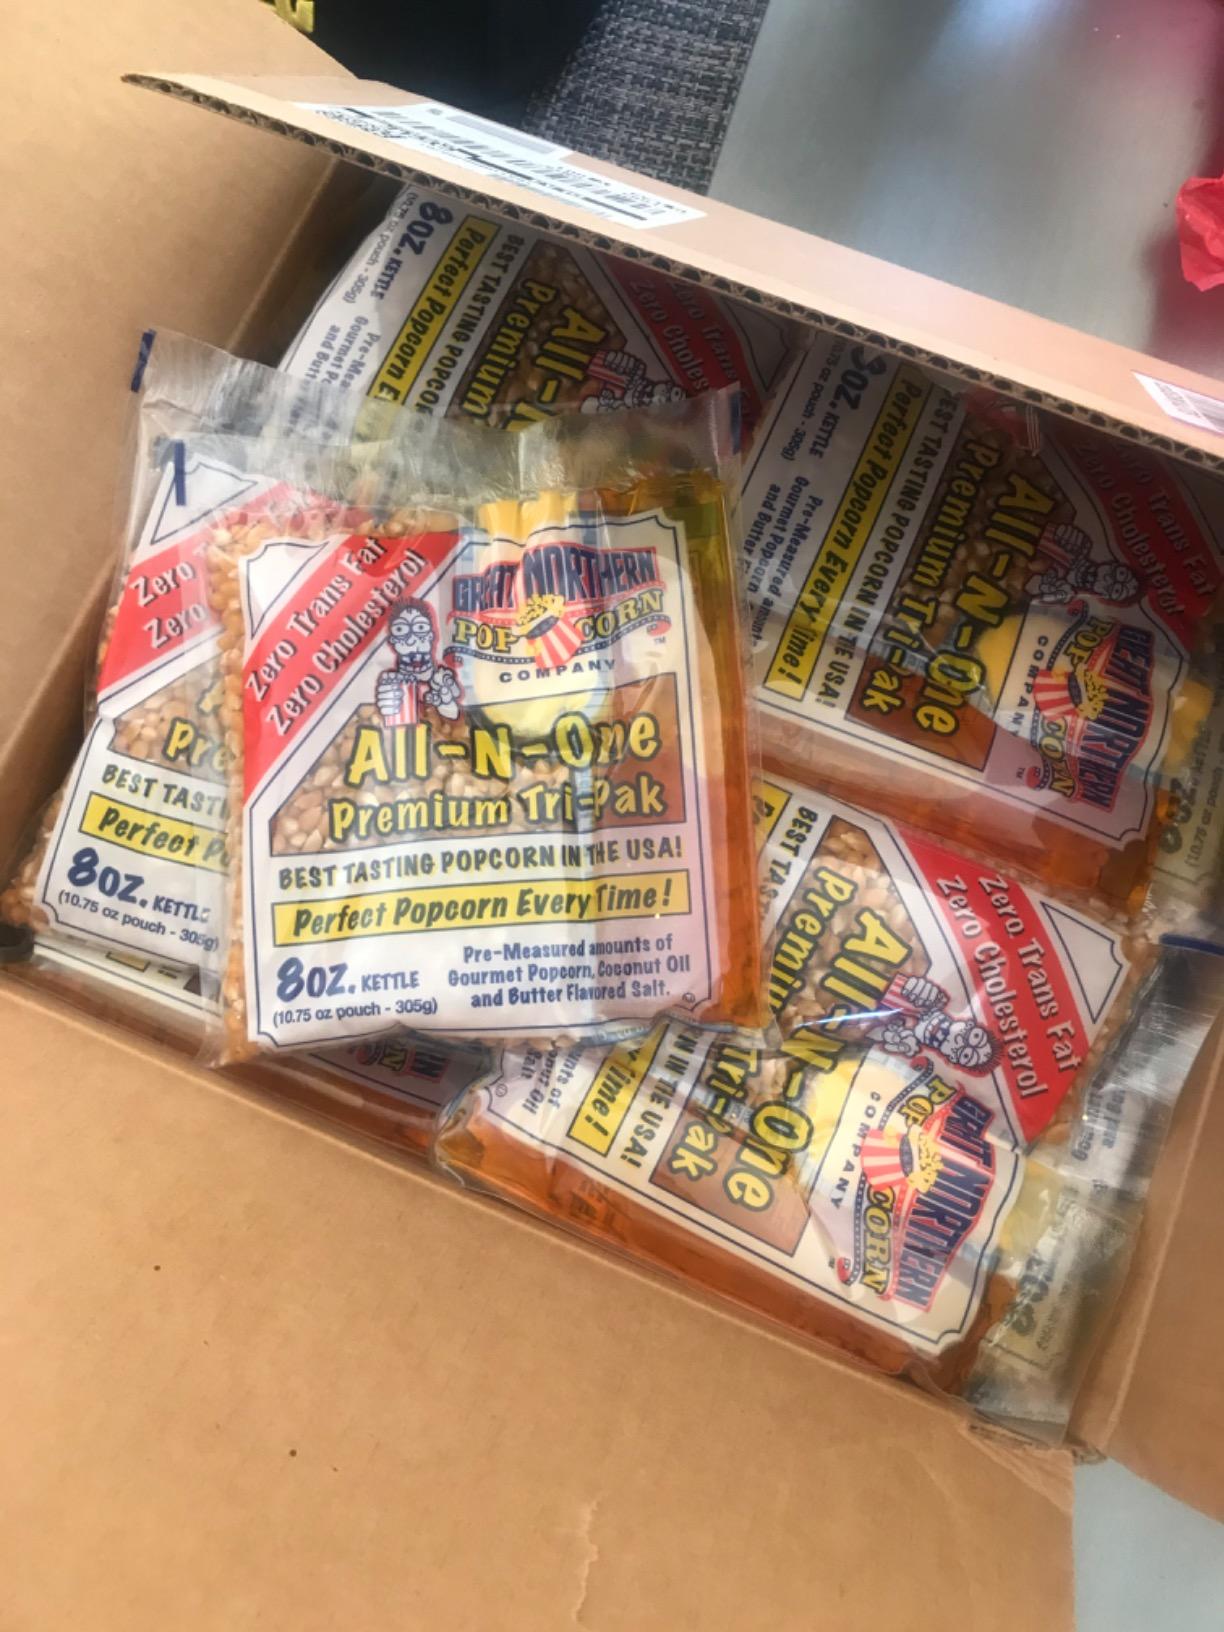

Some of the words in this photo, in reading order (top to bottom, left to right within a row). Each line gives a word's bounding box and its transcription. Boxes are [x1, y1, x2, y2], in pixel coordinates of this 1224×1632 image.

[370, 256, 404, 301] KETTLE
[432, 226, 488, 298] Perfect
[493, 233, 525, 275] BEST
[451, 273, 503, 344] TASTING
[320, 324, 341, 351] and
[330, 315, 369, 370] Gourmet
[384, 297, 447, 382] Popcorn
[460, 279, 560, 420] Premium
[802, 381, 825, 420] pouch
[874, 378, 923, 461] Perfect
[808, 411, 841, 460] KETTLE
[762, 483, 782, 513] and
[897, 434, 943, 513] TASTING
[774, 475, 811, 533] Gourmet
[830, 459, 889, 551] Popcorn
[908, 438, 1003, 591] Premium
[742, 511, 773, 557] Butter
[768, 494, 824, 598] Pre-Measured
[854, 512, 911, 606] POPCORN
[1112, 491, 1185, 617] Cholesterol
[129, 561, 197, 607] Zero
[452, 563, 518, 614] GREAT
[522, 544, 660, 601] NORTHERN
[799, 549, 849, 623] Every
[913, 471, 1055, 738] All-N-One
[1183, 553, 1218, 599] Fat
[143, 603, 211, 650] Zero
[244, 638, 299, 703] Zero
[286, 573, 354, 639] Trans
[338, 536, 389, 577] Fat
[266, 672, 326, 737] Zero
[311, 547, 429, 675] Cholesterol
[452, 616, 521, 654] POP
[572, 587, 665, 643] CORN
[653, 636, 667, 645] TM
[843, 607, 871, 633] IN
[1063, 616, 1116, 671] POP
[498, 658, 617, 684] COMPANY
[860, 593, 938, 715] Tri-ak
[815, 660, 851, 708] USA!
[343, 711, 662, 789] All-N-One
[101, 762, 158, 798] BEST
[327, 790, 513, 843] Premium
[517, 770, 667, 824] Tri-Pak
[97, 806, 200, 857] Perfect
[778, 805, 819, 858] BEST
[278, 864, 337, 891] BEST
[343, 851, 436, 884] TASTING
[440, 843, 555, 873] POPCORN
[561, 843, 582, 868] IN
[626, 834, 683, 860] USA!
[58, 889, 99, 914] (10.75
[101, 906, 120, 921] oz
[121, 912, 167, 937] pouch
[293, 901, 388, 938] Perfect
[393, 894, 509, 929] Popcorn
[515, 888, 593, 919] Every
[447, 966, 524, 988] Gourmet
[526, 962, 596, 983] Popcorn,
[597, 957, 661, 978] Coconut
[463, 939, 586, 964] Pre-Measured
[588, 936, 651, 957] amounts
[655, 933, 674, 951] of
[978, 873, 1025, 940] Zero
[1017, 937, 1060, 1021] Trans
[1046, 1020, 1084, 1073] Fat
[360, 971, 420, 993] KETTLE
[470, 989, 504, 1009] and
[508, 986, 563, 1005] Butter
[566, 981, 627, 1001] Flavored
[631, 979, 671, 998] Salt.
[936, 873, 982, 939] Zero
[972, 941, 1049, 1098] Cholesterol
[272, 1007, 313, 1028] (10.75
[315, 1008, 333, 1020] oz
[335, 1001, 381, 1020] pouch
[394, 997, 438, 1016] 305g)
[664, 1054, 690, 1077] IN
[722, 907, 913, 1213] All-N-One
[547, 1087, 562, 1110] of
[897, 1074, 957, 1129] POP
[620, 1109, 664, 1169] USA!
[829, 1090, 882, 1210] COMPANY
[939, 1096, 995, 1169] GREAT
[859, 1183, 897, 1296] CORN
[895, 1157, 993, 1308] NORTHERN
